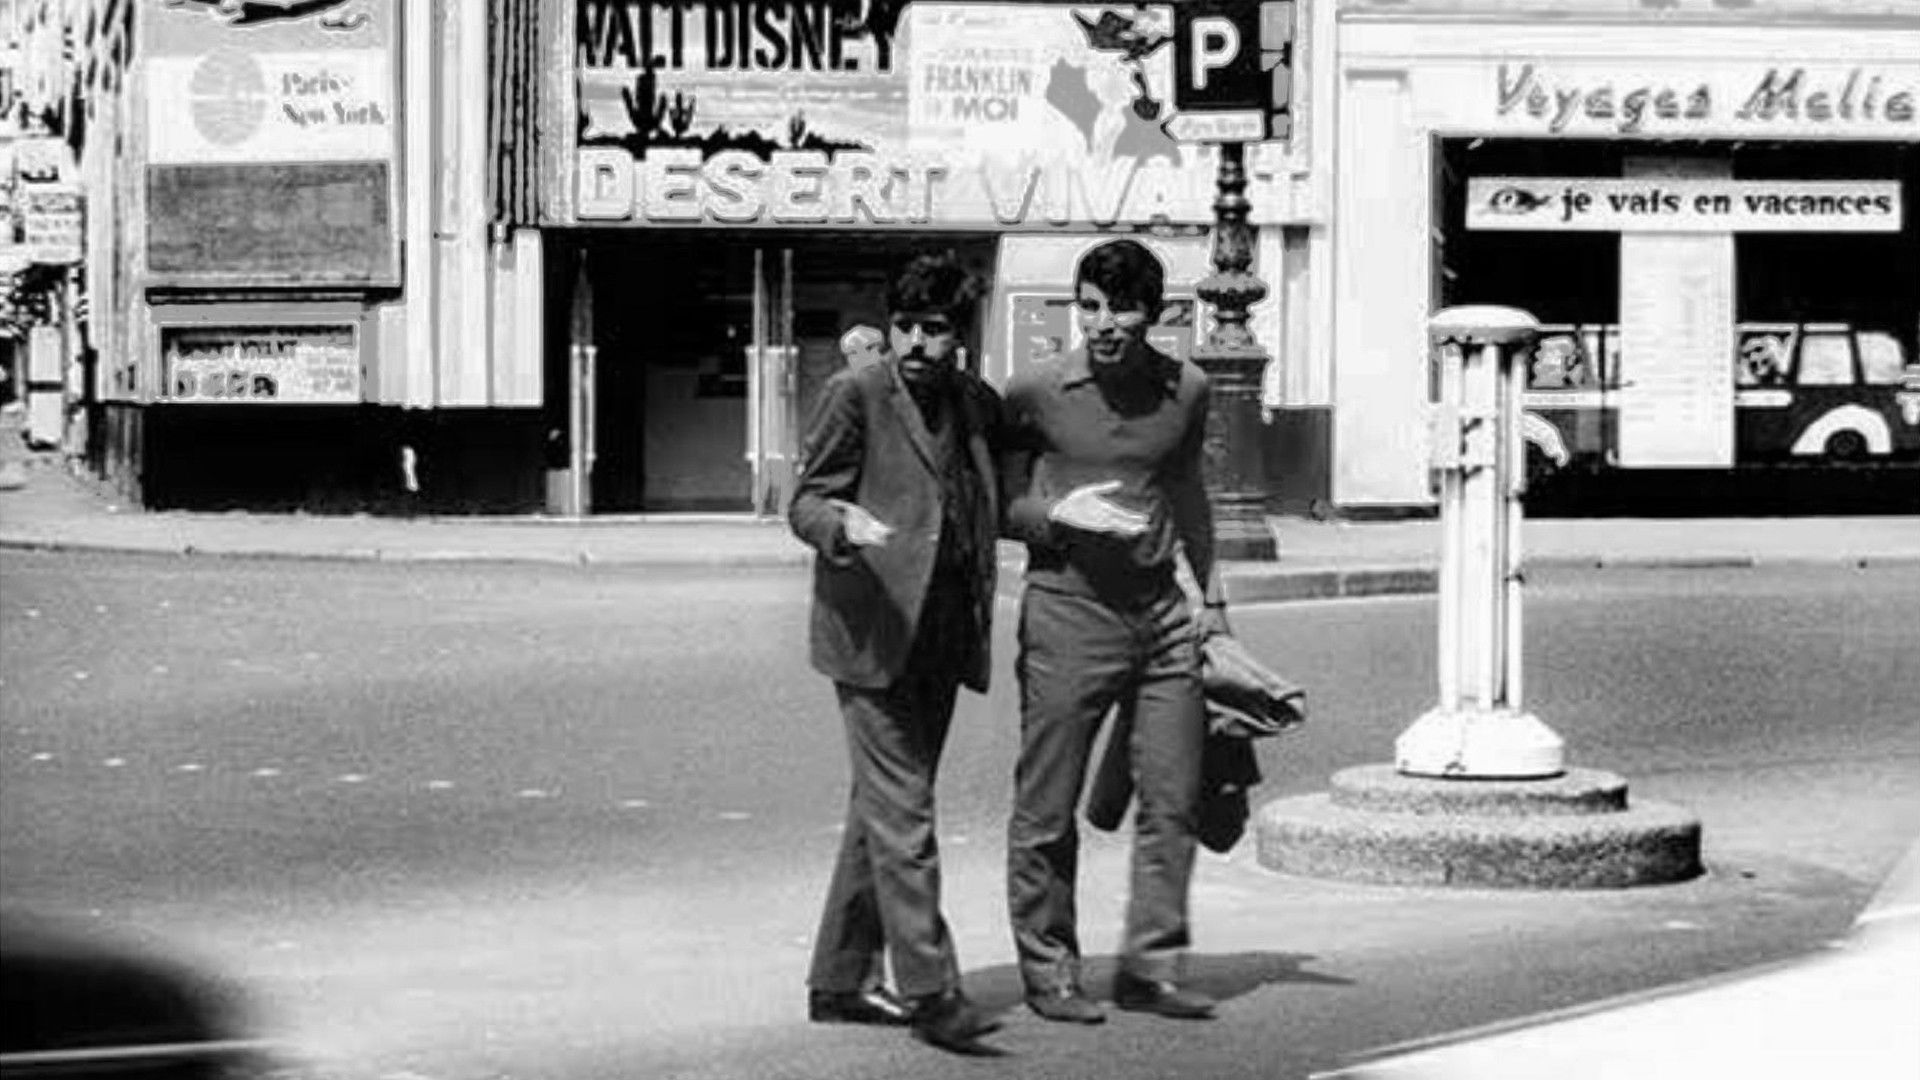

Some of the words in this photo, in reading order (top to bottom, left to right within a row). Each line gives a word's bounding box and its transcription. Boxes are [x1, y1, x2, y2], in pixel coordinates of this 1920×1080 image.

[705, 0, 899, 69] DISNEY
[1192, 17, 1240, 89] P
[923, 64, 1032, 95] FRANKLIN
[952, 96, 1018, 121] MOI
[1497, 63, 1711, 133] Voyages
[577, 150, 946, 224] DESERT
[1561, 188, 1592, 222] je
[1608, 189, 1681, 214] vais
[1693, 194, 1732, 215] en
[1744, 190, 1893, 216] vacances
